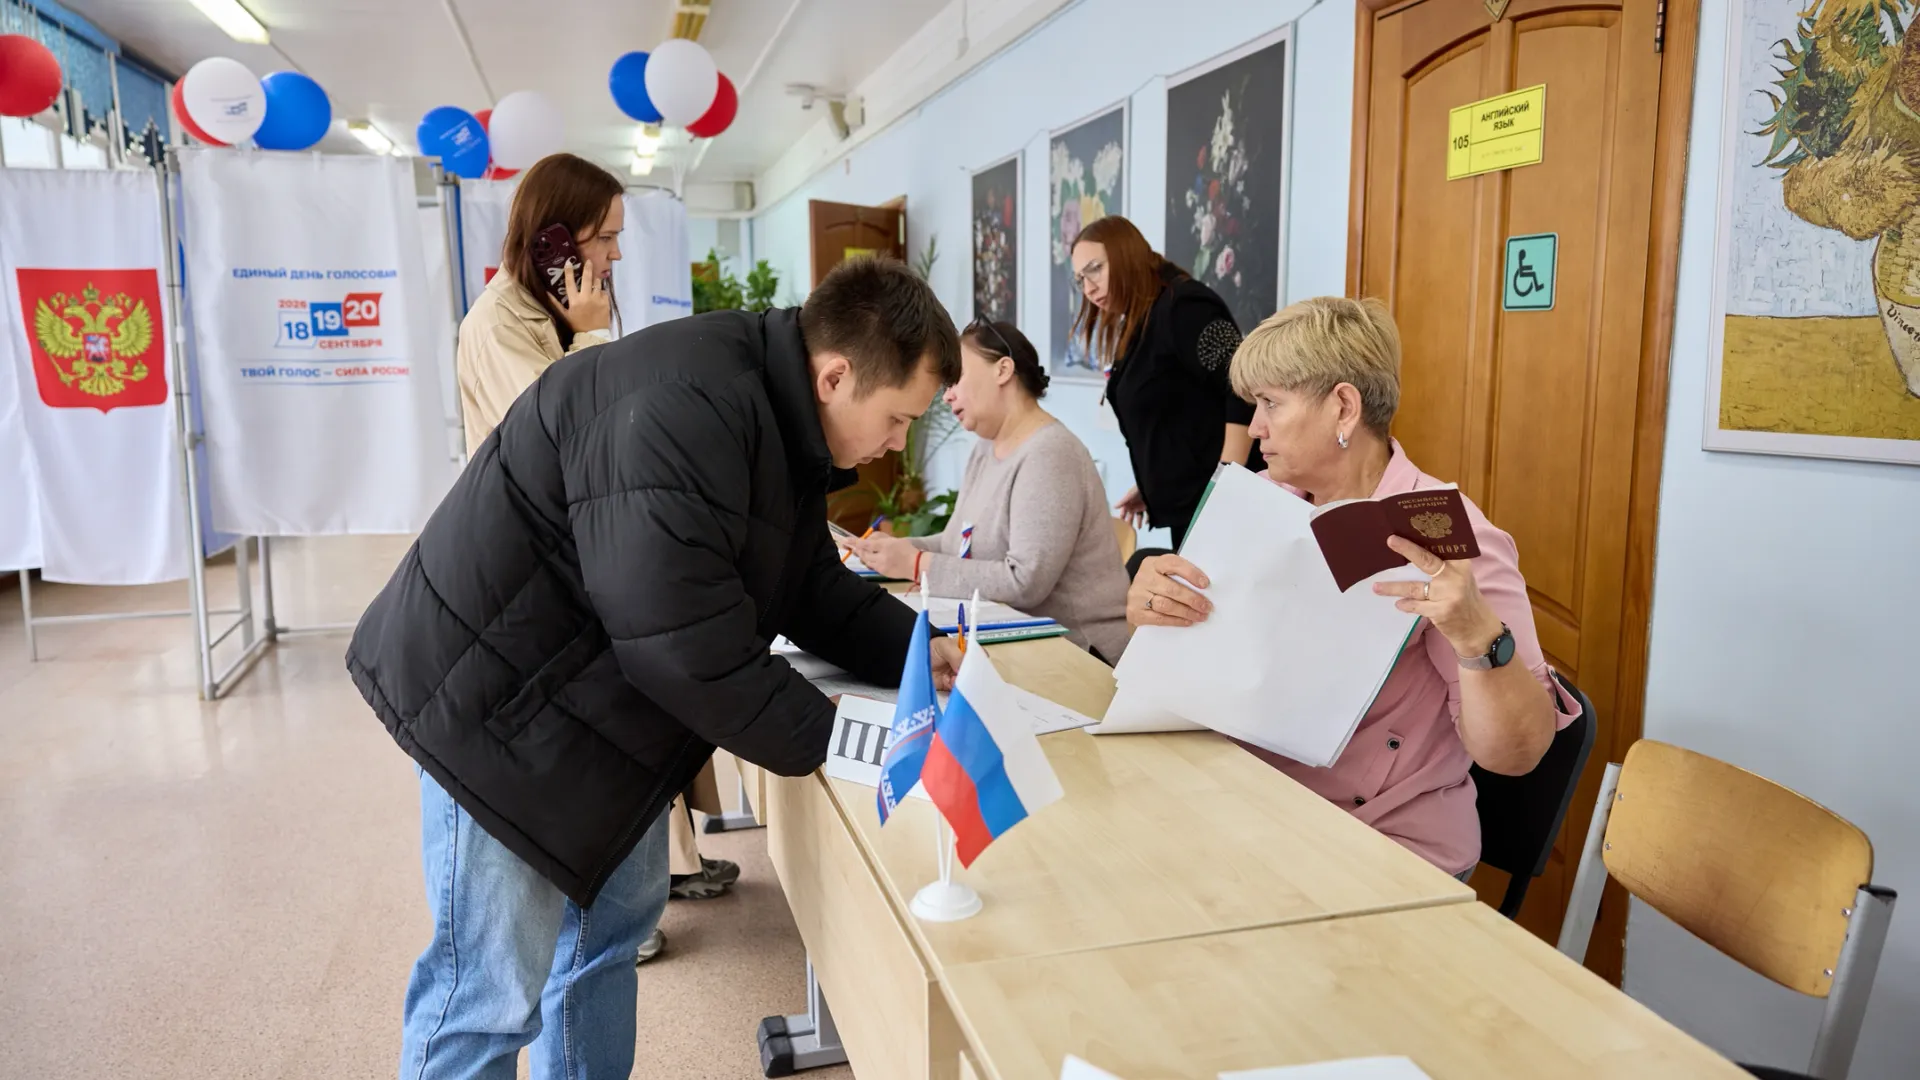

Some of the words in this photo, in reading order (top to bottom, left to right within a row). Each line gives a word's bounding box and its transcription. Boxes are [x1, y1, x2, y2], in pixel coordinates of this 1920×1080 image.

[1481, 101, 1529, 121] АНГЛИЙСКИЙ
[1493, 118, 1515, 131] ЯЗЫК
[1453, 135, 1469, 151] 105
[232, 267, 287, 279] ЕДИНЫЙ
[290, 270, 324, 281] ДЕНЬ
[278, 299, 307, 309] 2026
[284, 321, 309, 340] 18
[313, 309, 341, 331] 19
[345, 300, 377, 321] 20
[319, 338, 383, 350] СЕНТЯБРЯ
[241, 366, 276, 377] ТВОЙ
[278, 367, 320, 378] ГОЛОС
[335, 367, 369, 377] СИЛА
